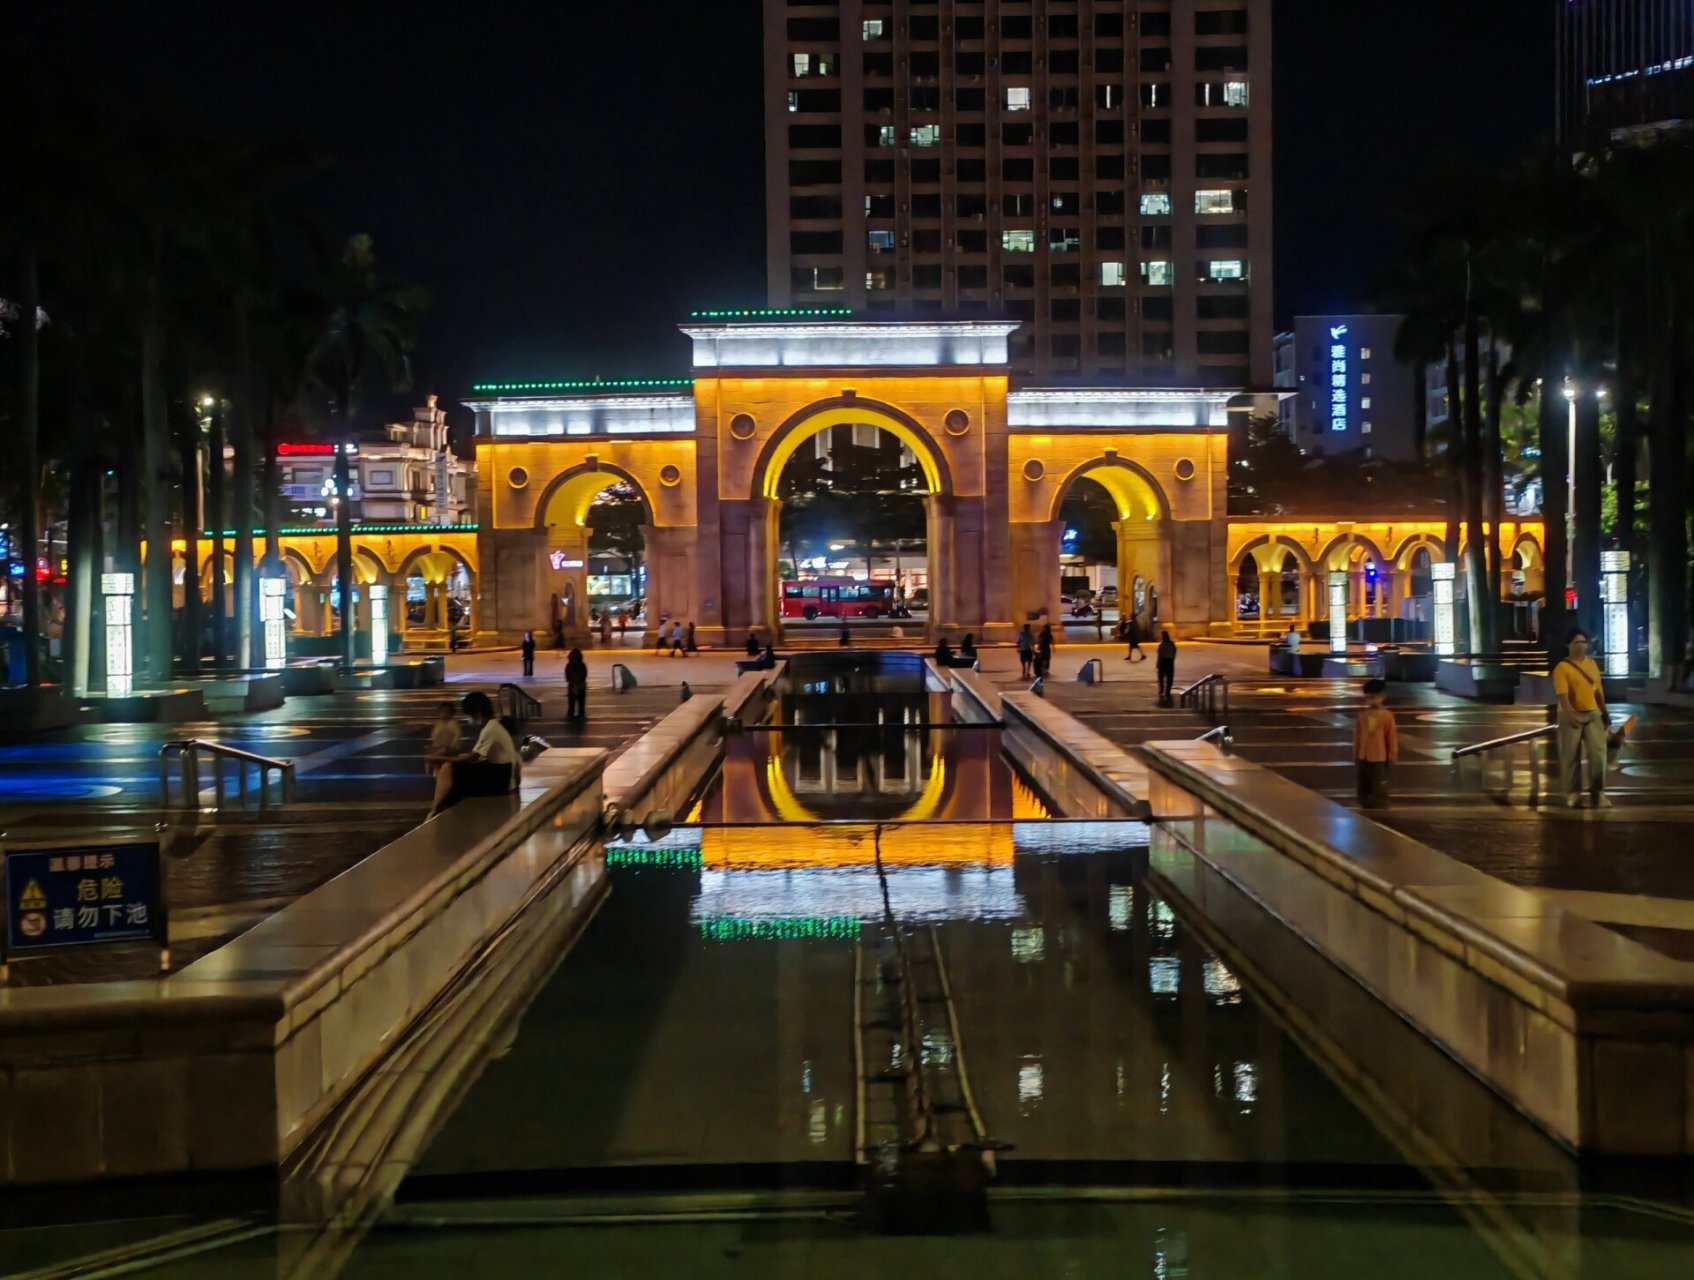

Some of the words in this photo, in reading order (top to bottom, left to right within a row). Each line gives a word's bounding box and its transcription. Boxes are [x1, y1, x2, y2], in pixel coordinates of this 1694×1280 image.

[77, 876, 124, 901] 危险
[53, 901, 148, 930] 请勿下池
